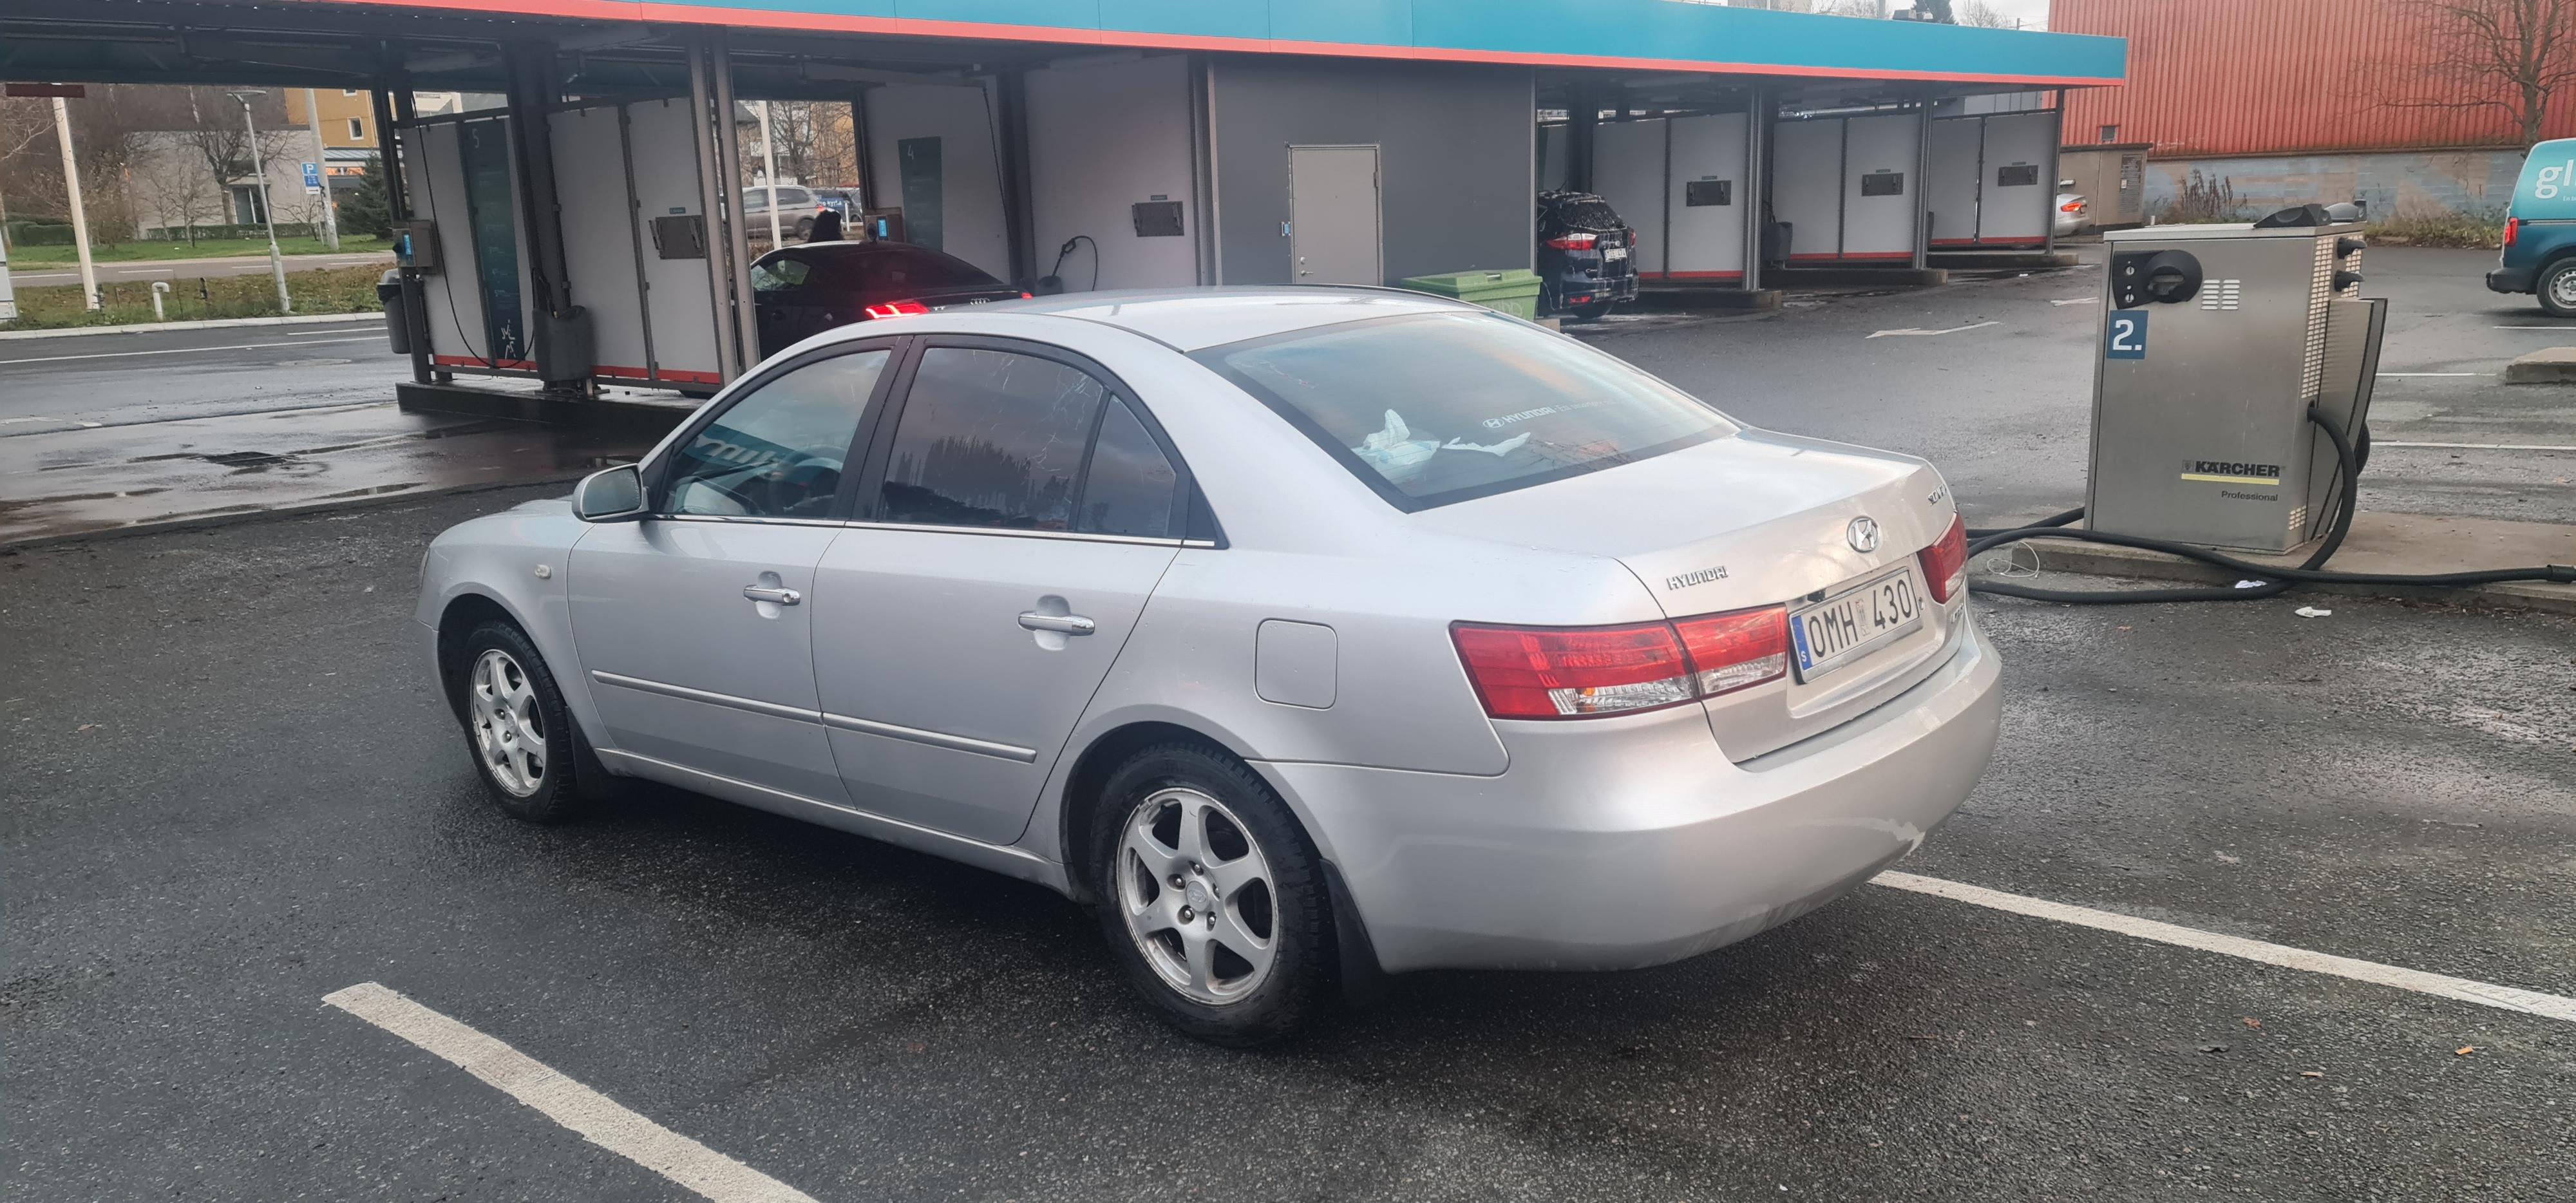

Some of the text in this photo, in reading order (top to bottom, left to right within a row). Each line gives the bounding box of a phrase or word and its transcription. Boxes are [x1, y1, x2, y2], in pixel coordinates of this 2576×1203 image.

[907, 144, 914, 160] 4
[306, 164, 314, 174] P
[2535, 159, 2576, 199] gl
[2113, 319, 2142, 350] 2.
[1502, 406, 1556, 423] HYUNDAI
[2195, 460, 2280, 477] KÄRCHER
[2221, 490, 2278, 502] Professional
[1666, 565, 1728, 591] HYUNDAI
[1809, 579, 1912, 658] OMH 430
[1801, 650, 1807, 662] S
